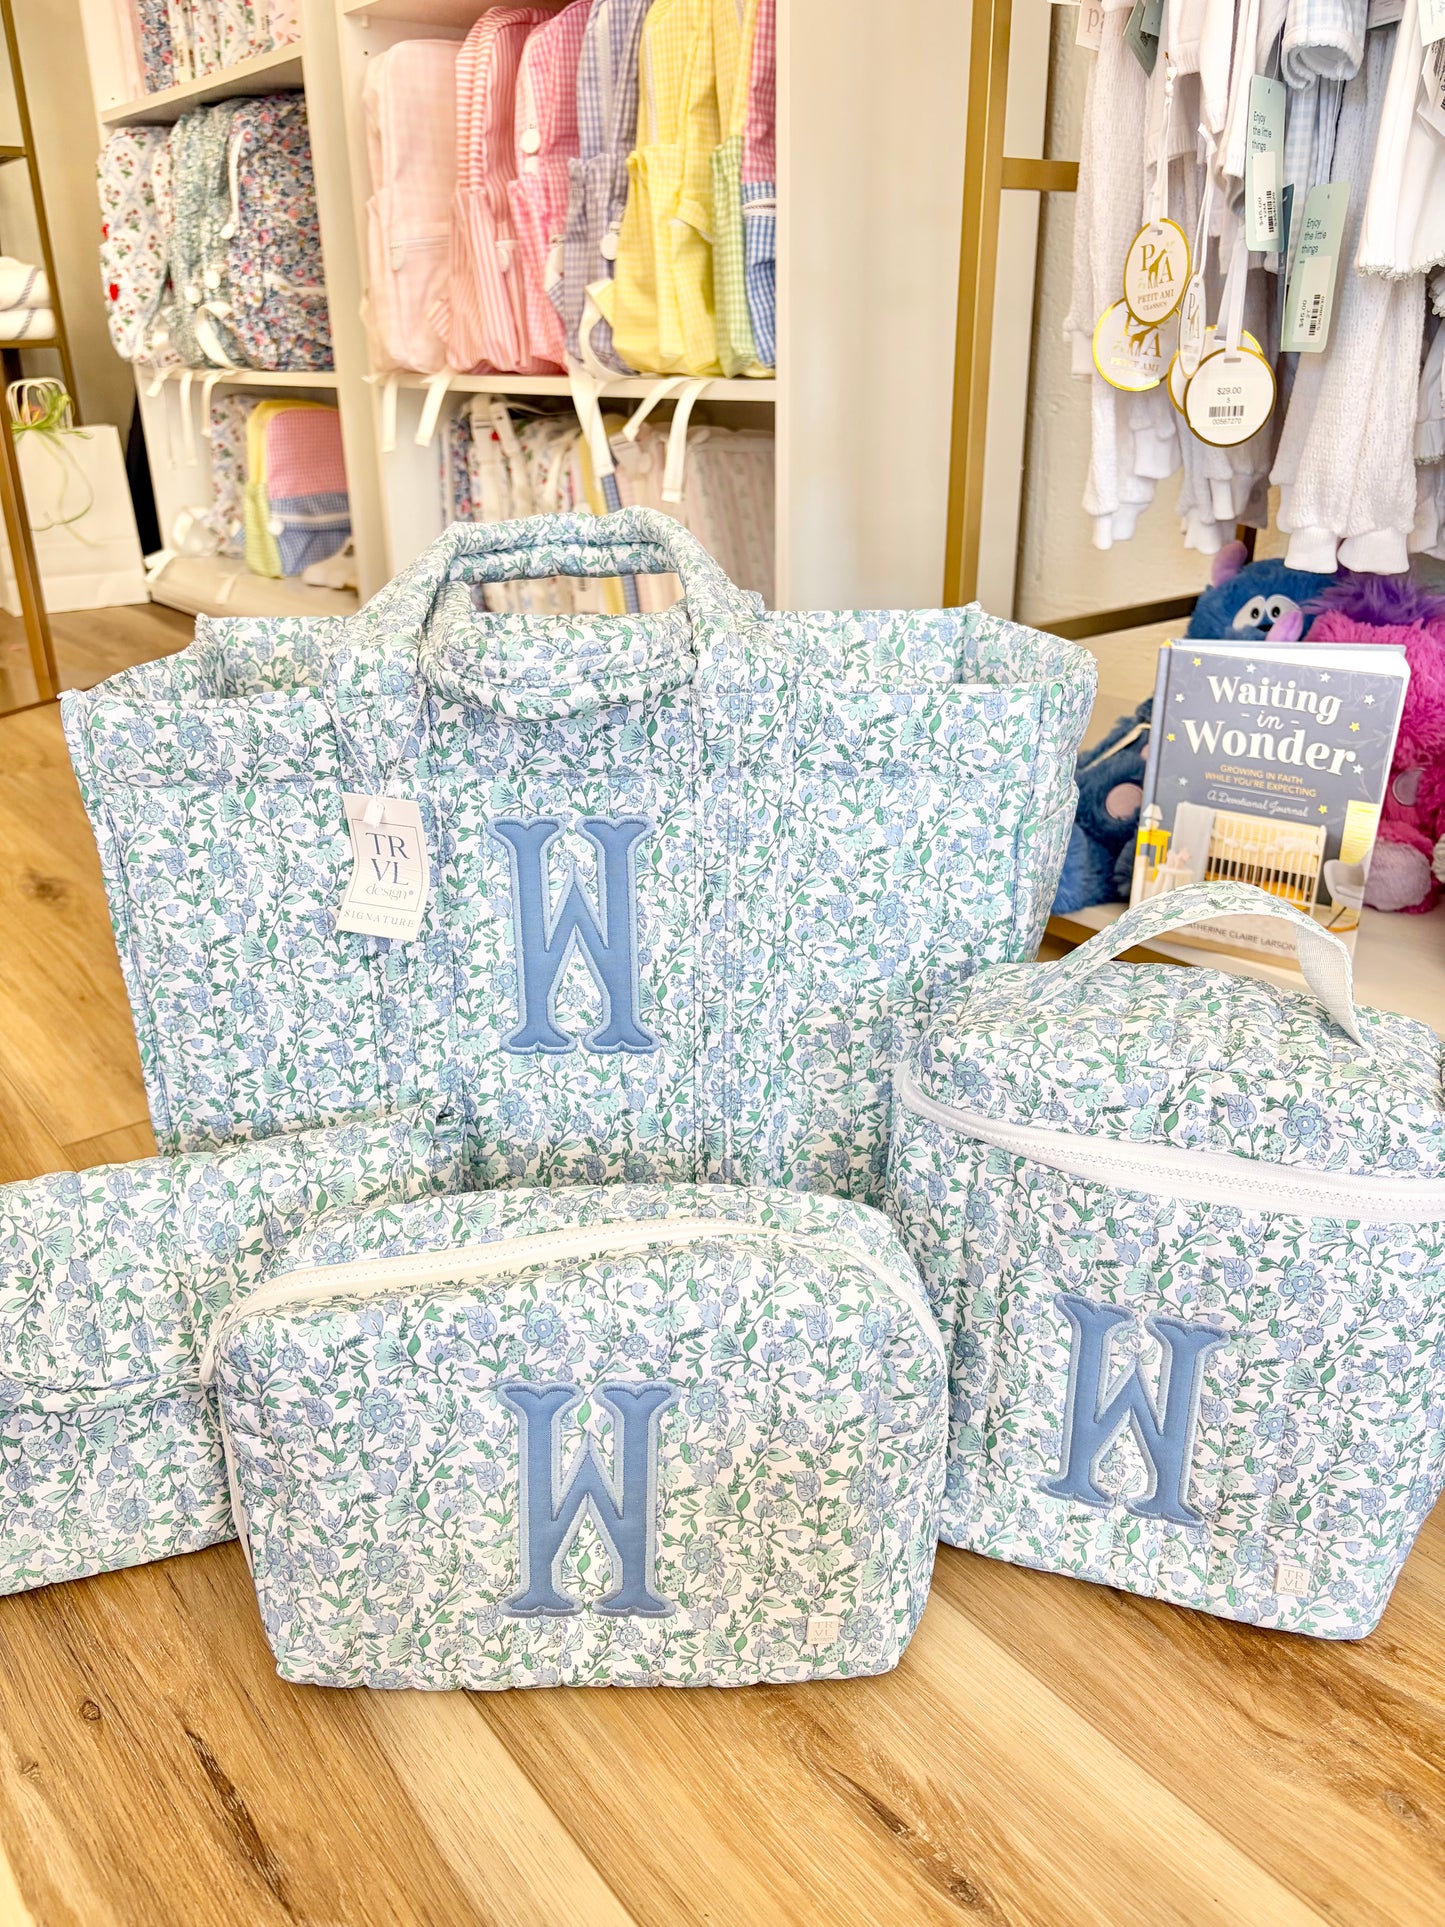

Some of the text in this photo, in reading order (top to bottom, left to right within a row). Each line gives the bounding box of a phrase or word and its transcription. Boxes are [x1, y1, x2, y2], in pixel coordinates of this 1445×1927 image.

[1253, 110, 1266, 125] Enjoy
[1252, 125, 1272, 138] the little
[1251, 139, 1267, 153] things
[1306, 217, 1321, 229] Enjoy
[1304, 230, 1327, 240] the little
[1301, 245, 1319, 256] things
[1137, 288, 1175, 304] PETIT AMI
[1216, 387, 1242, 396] $29.00
[1206, 675, 1344, 726] Waiting
[1256, 710, 1285, 730] in
[1181, 719, 1358, 776] Wonder
[1220, 764, 1303, 785] GROWING IN FAITH
[1205, 772, 1317, 798] WHILE YOU'RE EXPECTING
[1206, 789, 1309, 817] A Devotional Journal
[365, 832, 410, 860] TR
[370, 858, 409, 886] VL
[365, 883, 407, 901] design
[343, 909, 415, 928] SIGNATURE
[487, 815, 661, 1055] W
[1184, 921, 1296, 952] ATHERINE CLAIRE LARSON
[1038, 1293, 1231, 1528] W
[497, 1381, 681, 1618] W
[1283, 1569, 1304, 1581] TR
[1284, 1578, 1304, 1590] VL
[1280, 1586, 1304, 1596] design
[814, 1621, 833, 1629] TR
[815, 1629, 833, 1637] VL
